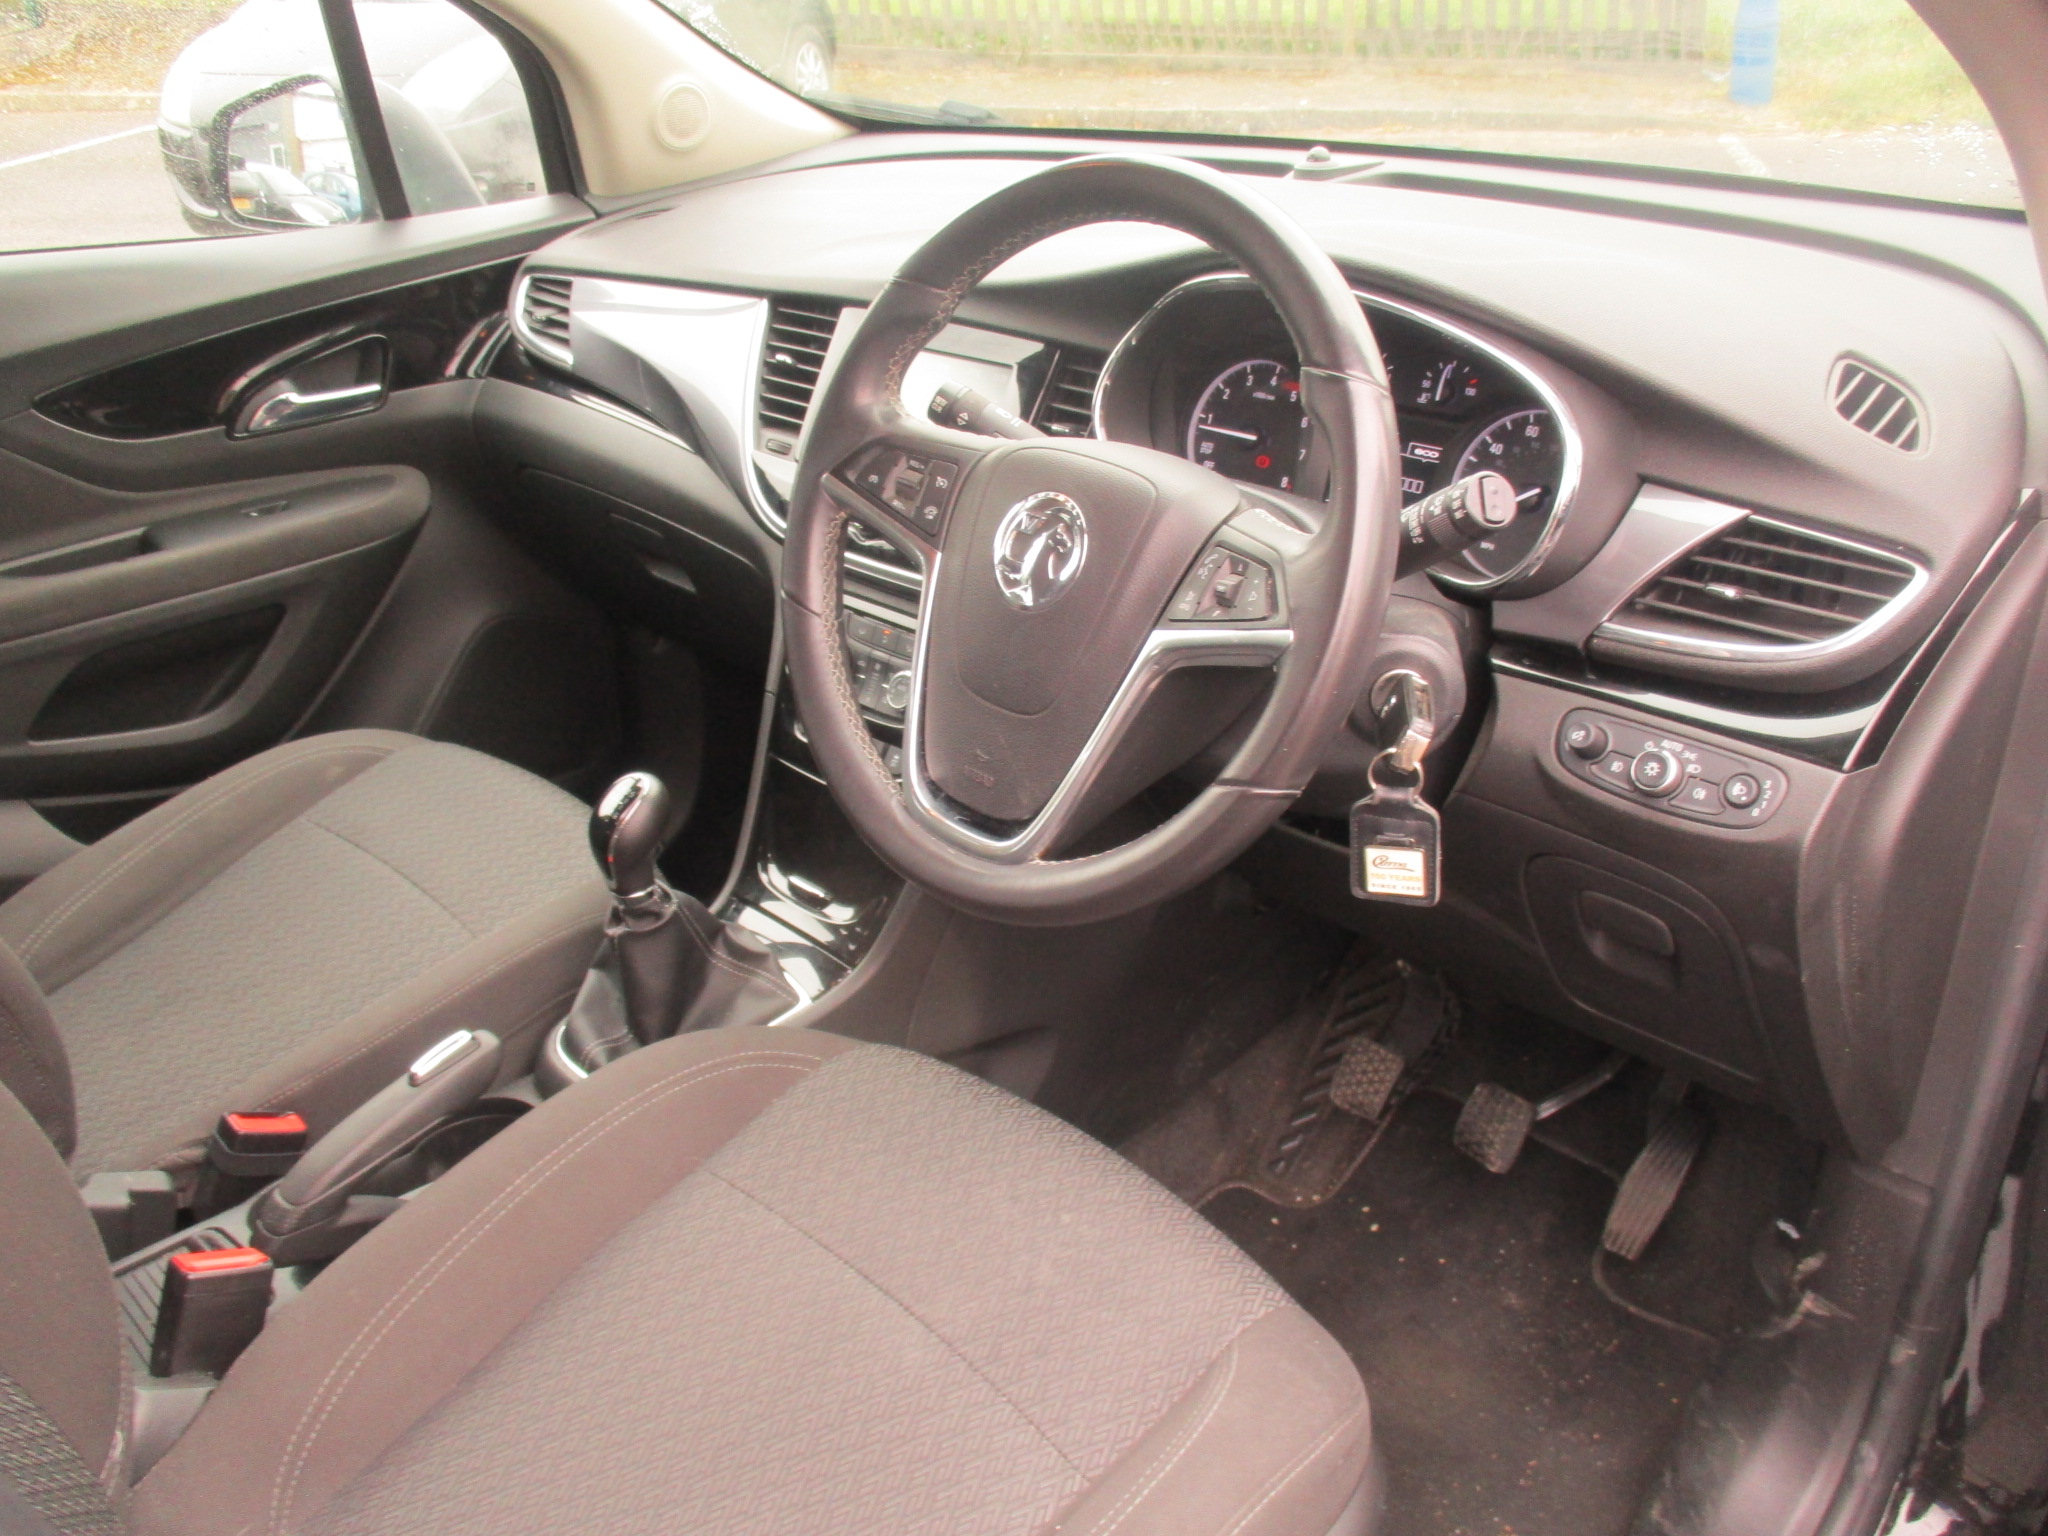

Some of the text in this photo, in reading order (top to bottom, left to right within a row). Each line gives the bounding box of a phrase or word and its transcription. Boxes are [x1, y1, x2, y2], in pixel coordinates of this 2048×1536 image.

[1246, 375, 1254, 386] 3
[1270, 375, 1278, 387] 4
[1222, 388, 1231, 400] 2
[1290, 390, 1298, 402] 5
[1207, 413, 1213, 425] 1
[1300, 416, 1309, 428] 6
[1524, 424, 1540, 438] 60
[1299, 449, 1307, 461] 7
[1488, 443, 1504, 456] 40
[1280, 476, 1289, 488] 8
[1659, 739, 1684, 752] AUTO
[1763, 790, 1772, 799] 2
[1761, 801, 1767, 809] 1
